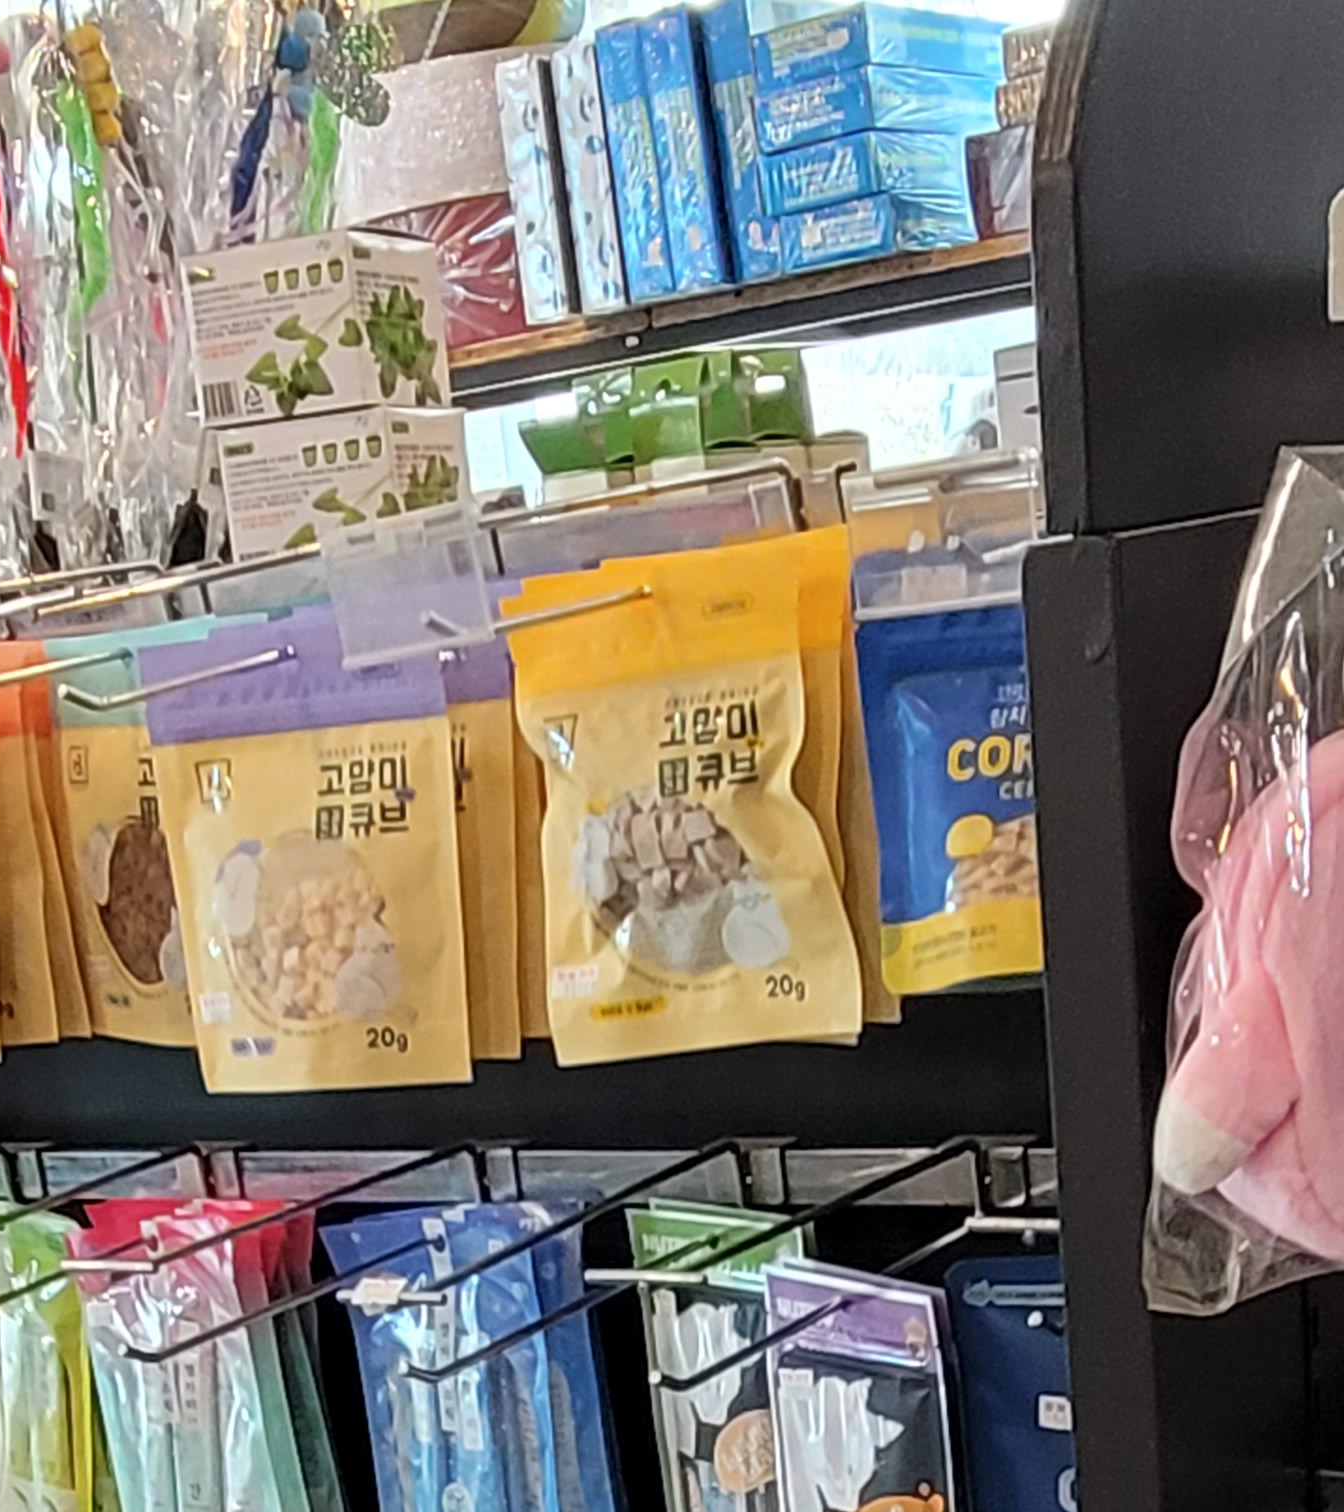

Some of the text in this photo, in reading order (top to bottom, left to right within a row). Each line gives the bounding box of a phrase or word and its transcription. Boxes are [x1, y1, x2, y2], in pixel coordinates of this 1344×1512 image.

[695, 751, 759, 792] 큐브
[349, 801, 409, 838] 큐브
[765, 974, 807, 1001] 20g
[365, 1026, 409, 1052] 20g
